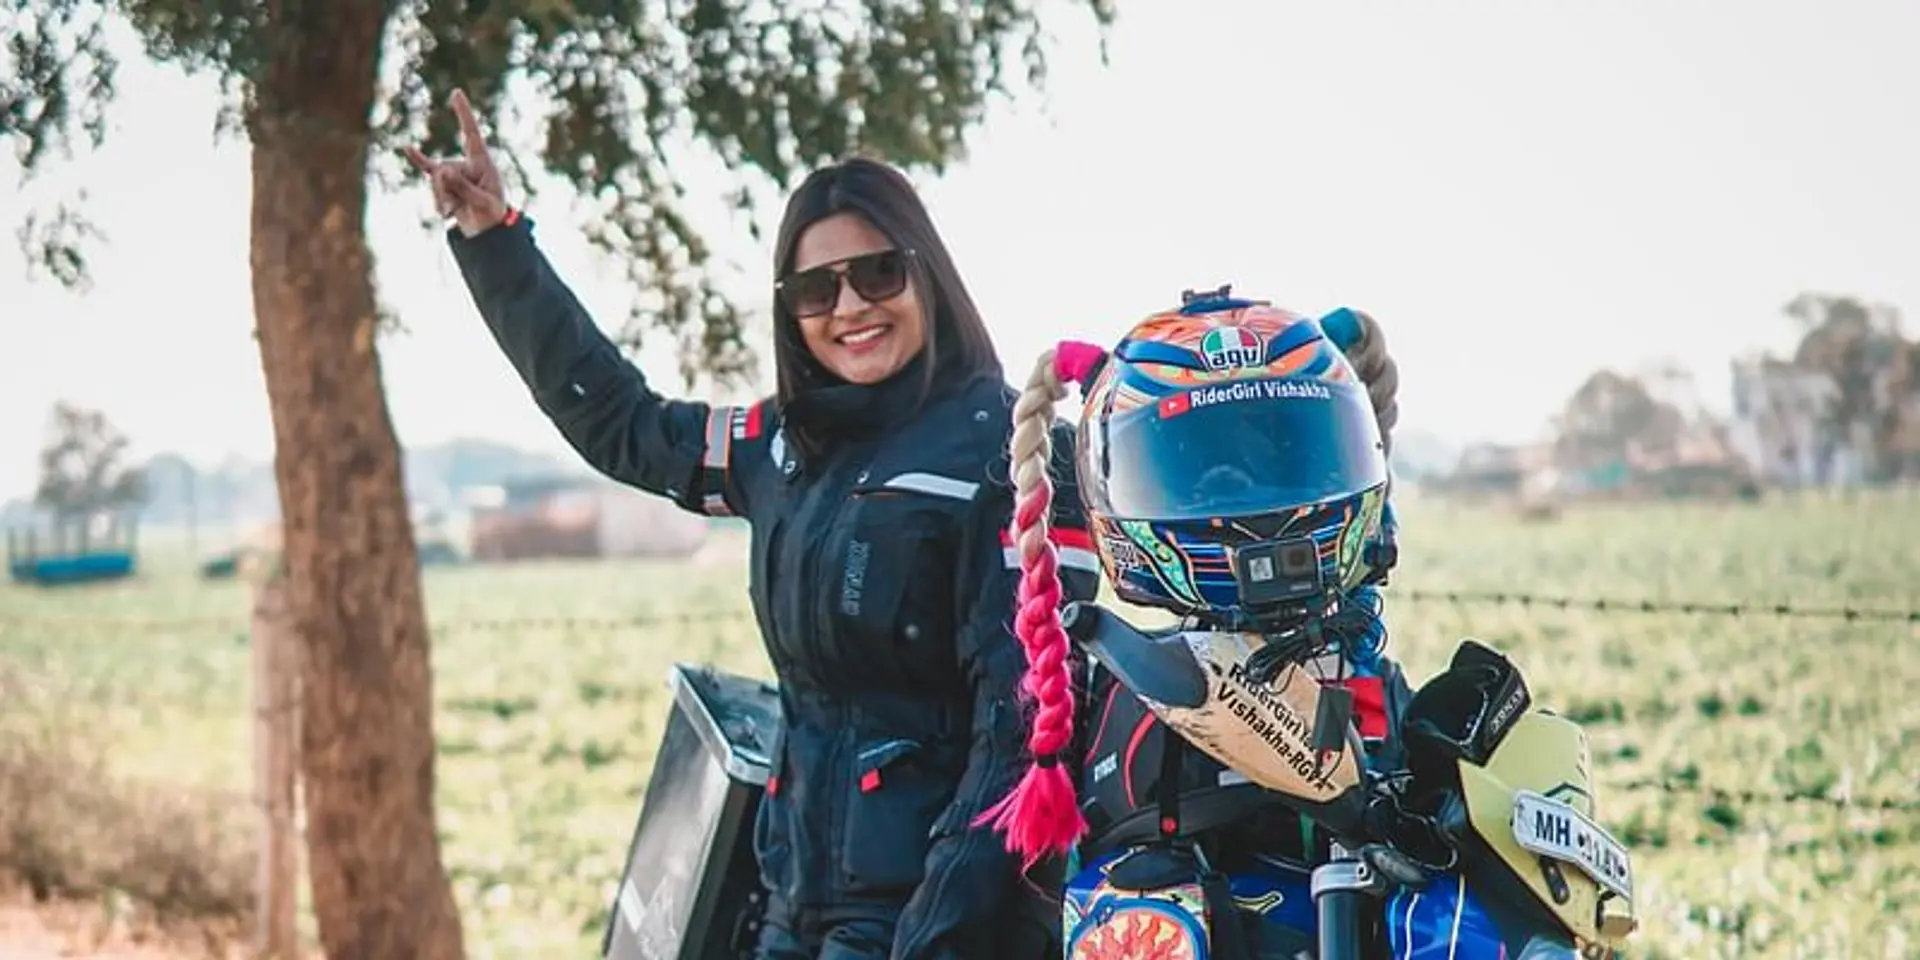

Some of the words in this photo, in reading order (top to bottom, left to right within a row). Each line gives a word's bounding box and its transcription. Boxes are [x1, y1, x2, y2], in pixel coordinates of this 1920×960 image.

[1211, 349, 1259, 369] agv
[1191, 382, 1262, 407] RiderGirl
[1264, 379, 1330, 400] Vishakha
[1535, 809, 1571, 847] MH
